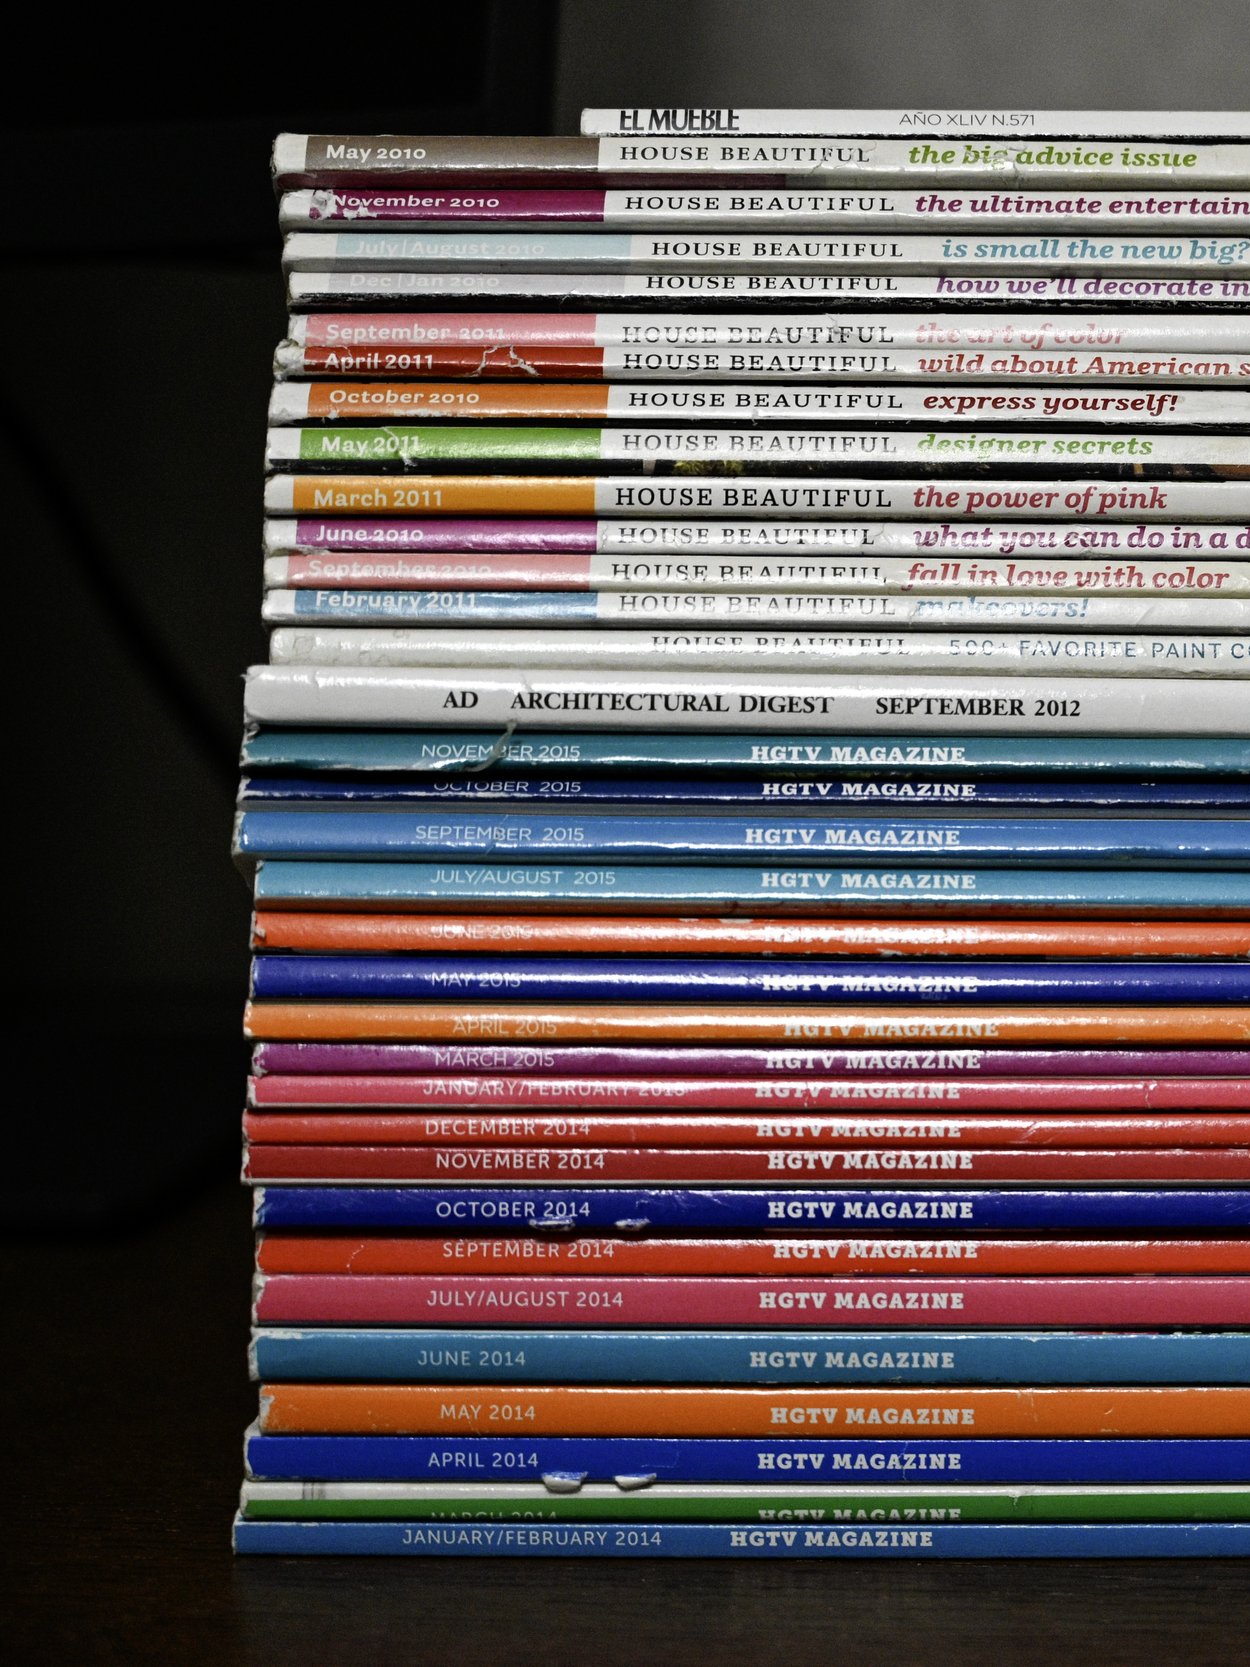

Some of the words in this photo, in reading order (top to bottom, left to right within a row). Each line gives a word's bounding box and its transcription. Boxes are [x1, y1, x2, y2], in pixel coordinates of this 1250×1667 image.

[620, 110, 644, 130] EL
[648, 110, 739, 130] MUEBLE
[900, 113, 941, 126] AÑO
[947, 114, 987, 126] XLIV
[993, 114, 1035, 126] N.571
[326, 145, 371, 161] May
[377, 148, 425, 160] 2010
[621, 147, 708, 161] HOUSE
[721, 148, 870, 163] BEAUTIFUL
[909, 146, 954, 163] the
[1016, 149, 1113, 166] advice
[1121, 149, 1197, 167] issue
[334, 195, 444, 209] November
[450, 198, 499, 209] 2010
[625, 197, 719, 210] HOUSE
[730, 198, 894, 211] BEAUTIFUL
[916, 195, 963, 212] the
[970, 195, 1102, 214] ultimate
[653, 242, 740, 256] HOUSE
[752, 243, 903, 257] BEAUTIFUL
[942, 241, 969, 258] is
[974, 240, 1061, 259] small
[1067, 241, 1114, 259] the
[1120, 245, 1182, 260] new
[1189, 242, 1250, 264] big?
[936, 274, 1000, 293] how
[1006, 277, 1077, 294] we'll
[1084, 279, 1212, 297] decorate
[1220, 281, 1250, 297] in
[325, 354, 380, 373] April
[385, 354, 433, 370] 2011
[918, 354, 985, 373] wild
[991, 356, 1077, 374] about
[1082, 357, 1232, 375] American
[330, 390, 423, 404] October
[429, 392, 479, 404] 2010
[629, 393, 725, 407] HOUSE
[735, 394, 903, 409] BEAUTIFUL
[923, 394, 1035, 415] express
[1042, 394, 1178, 415] yourself!
[322, 436, 369, 455] May
[373, 435, 419, 452] 2011
[313, 489, 387, 507] March
[394, 489, 442, 507] 2011
[616, 488, 712, 505] HOUSE
[723, 489, 891, 507] BEAUTIFUL
[913, 486, 959, 508] the
[964, 490, 1060, 513] power
[1065, 488, 1098, 513] of
[1099, 488, 1167, 514] pink
[316, 525, 367, 542] June
[373, 528, 423, 541] 2010
[913, 525, 993, 547] what
[1001, 532, 1059, 554] you
[1064, 531, 1120, 549] can
[1127, 526, 1164, 549] do
[1172, 528, 1202, 549] in
[1209, 533, 1229, 550] a
[1019, 641, 1136, 659] FAVORITE
[1152, 641, 1222, 659] PAINT
[443, 691, 478, 709] AD
[511, 693, 730, 713] ARCHITECTURAL
[740, 695, 833, 715] DIGEST
[875, 696, 1025, 716] SEPTEMBER
[1034, 699, 1080, 717] 2012
[539, 746, 580, 760] 2015
[751, 745, 819, 762] HGTV
[832, 747, 965, 763] MAGAZINE
[430, 870, 562, 885] JULY/AUGUST
[574, 872, 615, 884] 2015
[762, 872, 830, 888] HGTV
[841, 874, 976, 889] MAGAZINE
[436, 1153, 550, 1170] NOVEMBER
[558, 1153, 604, 1170] 2014
[768, 1153, 837, 1169] HGTV
[844, 1153, 973, 1169] MAGAZINE
[436, 1201, 536, 1218] OCTOBER
[544, 1202, 590, 1218] 2014
[769, 1202, 836, 1218] HGTV
[844, 1202, 973, 1218] MAGAZINE
[427, 1290, 567, 1308] JULY/AUGUST
[577, 1291, 623, 1307] 2014
[760, 1292, 826, 1308] HGTV
[834, 1292, 964, 1309] MAGAZINE
[418, 1351, 471, 1367] JUNE
[479, 1351, 525, 1366] 2014
[750, 1352, 817, 1368] HGTV
[825, 1352, 954, 1368] MAGAZINE
[428, 1452, 484, 1467] APRIL
[492, 1453, 538, 1467] 2014
[758, 1454, 824, 1470] HGTV
[832, 1454, 961, 1470] MAGAZINE
[403, 1530, 607, 1546] JANUARY/FEBRUARY
[615, 1531, 662, 1546] 2014
[731, 1531, 795, 1547] HGTV
[804, 1531, 932, 1548] MAGAZINE
